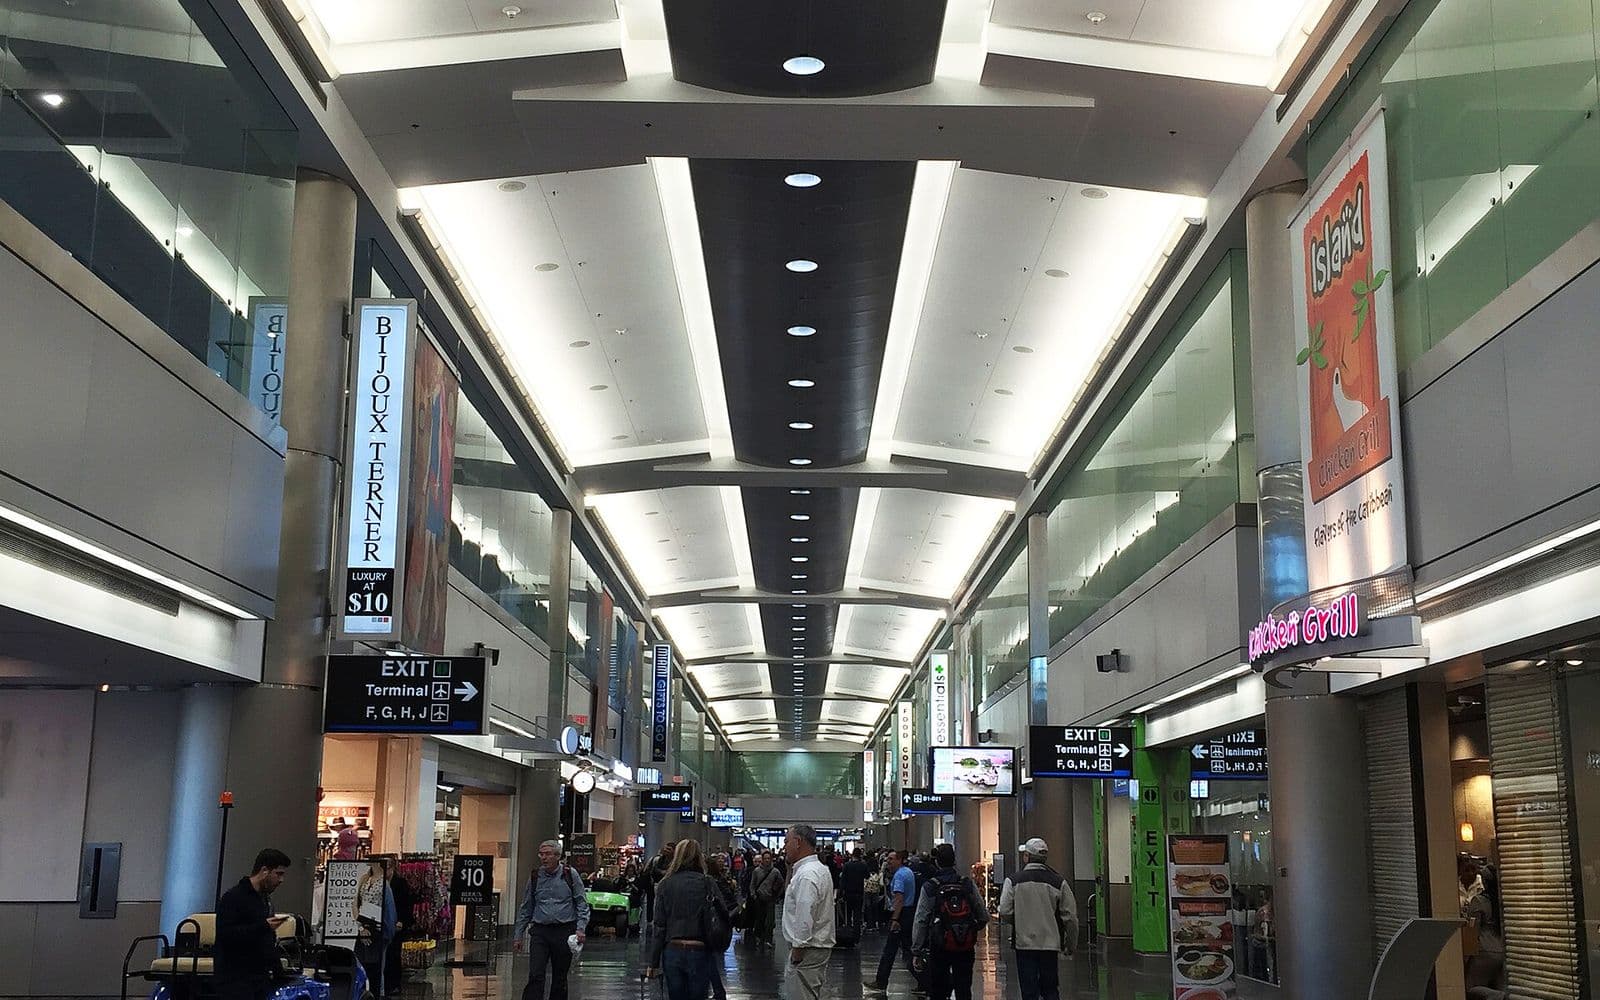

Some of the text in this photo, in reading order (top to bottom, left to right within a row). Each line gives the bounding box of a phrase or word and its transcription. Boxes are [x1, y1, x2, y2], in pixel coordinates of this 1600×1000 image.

[1311, 182, 1364, 297] Island
[362, 316, 391, 562] BIJOUX TERNER
[1359, 414, 1380, 461] Grill
[1358, 483, 1393, 521] Caribbean
[352, 572, 387, 581] LUXURY
[363, 582, 376, 591] AT
[348, 592, 388, 613] $10
[1303, 592, 1358, 644] Grill
[381, 660, 429, 677] EXIT
[656, 648, 668, 677] MIAMI
[366, 684, 428, 697] Terminal
[656, 680, 666, 708] GIFTS
[366, 706, 427, 720] F, G, H, J
[656, 709, 665, 723] TO
[934, 675, 946, 743] essentials
[1064, 729, 1096, 740] EXIT
[1055, 744, 1097, 754] Terminal
[1057, 759, 1098, 769] F, G, H, J
[331, 863, 359, 871] EVERY
[1146, 831, 1159, 907] EXIT
[330, 879, 357, 887] TODO
[461, 868, 484, 887] $10
